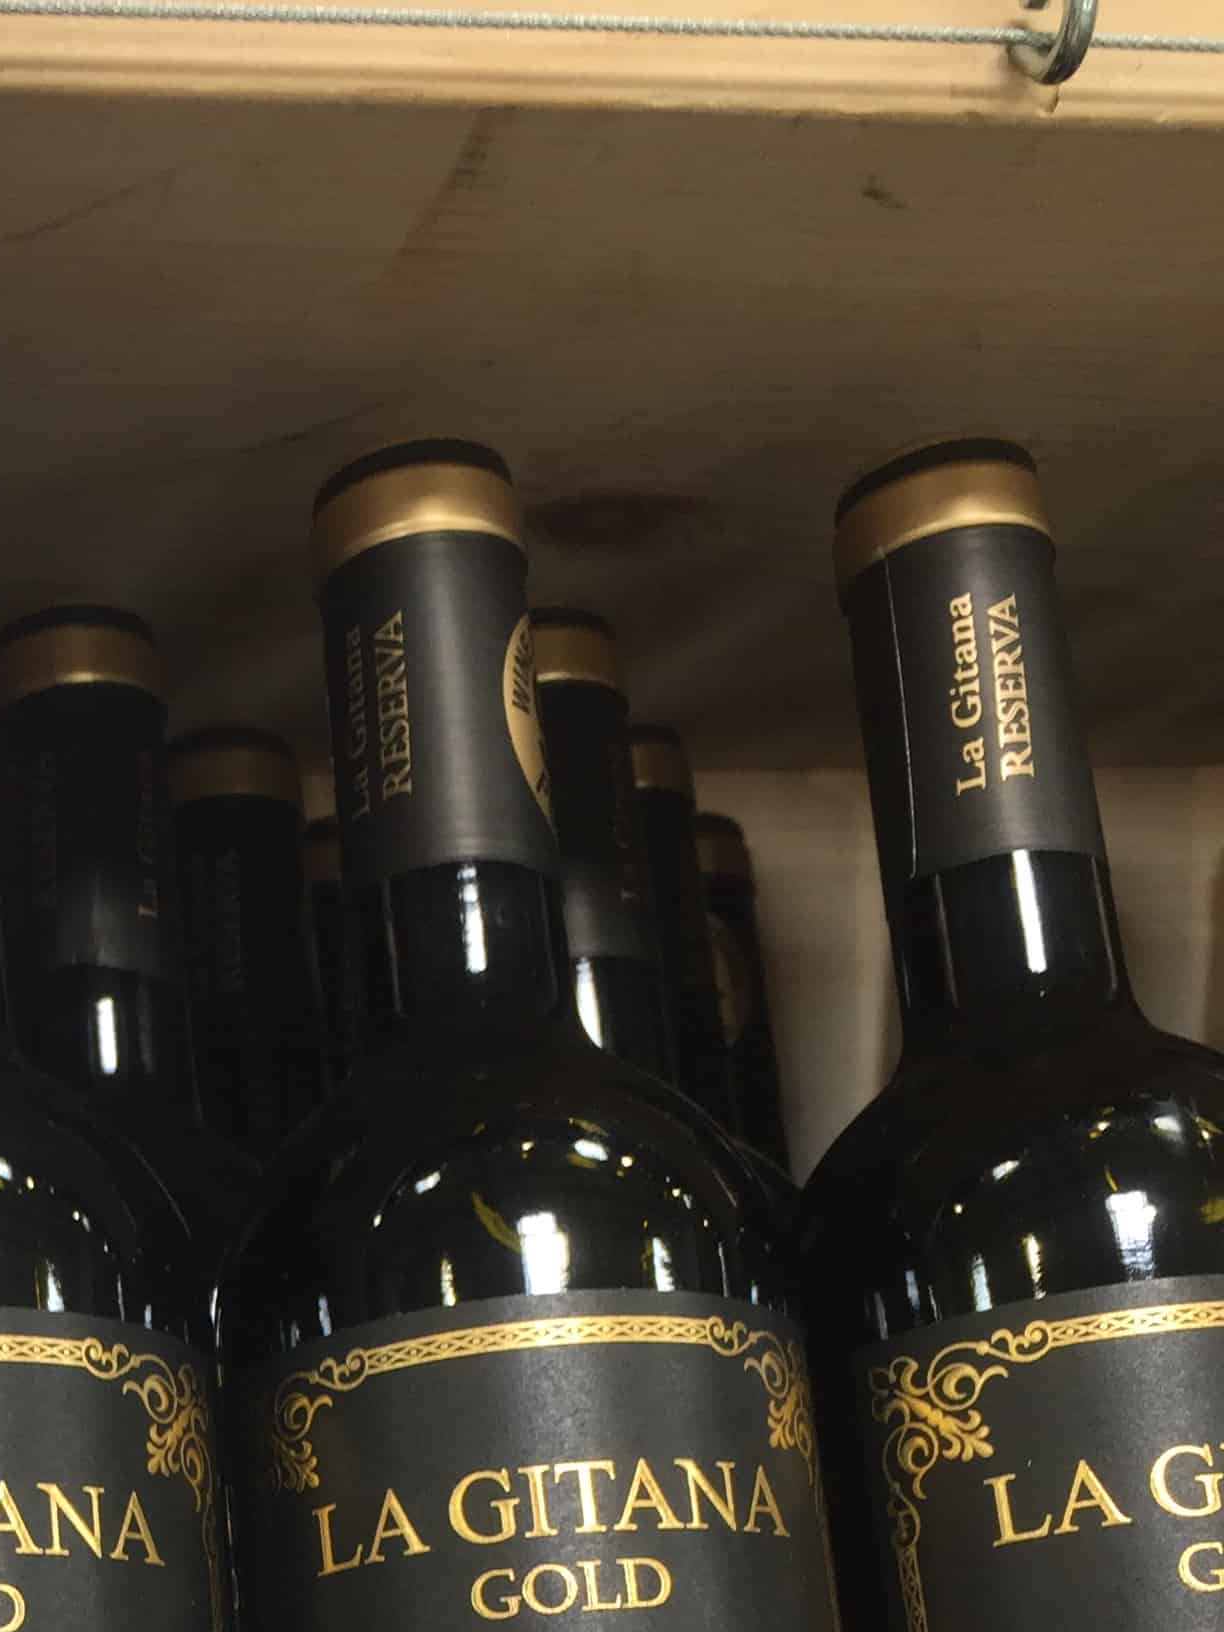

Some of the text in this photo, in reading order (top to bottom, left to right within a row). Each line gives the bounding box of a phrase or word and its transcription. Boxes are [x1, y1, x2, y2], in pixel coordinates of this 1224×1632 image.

[373, 609, 414, 801] RESERVA
[949, 591, 986, 796] La Gitana
[987, 593, 1035, 782] RESERVA
[311, 1456, 791, 1576] LA GITANA
[983, 1459, 1132, 1548] LA
[470, 1556, 673, 1621] GOLD
